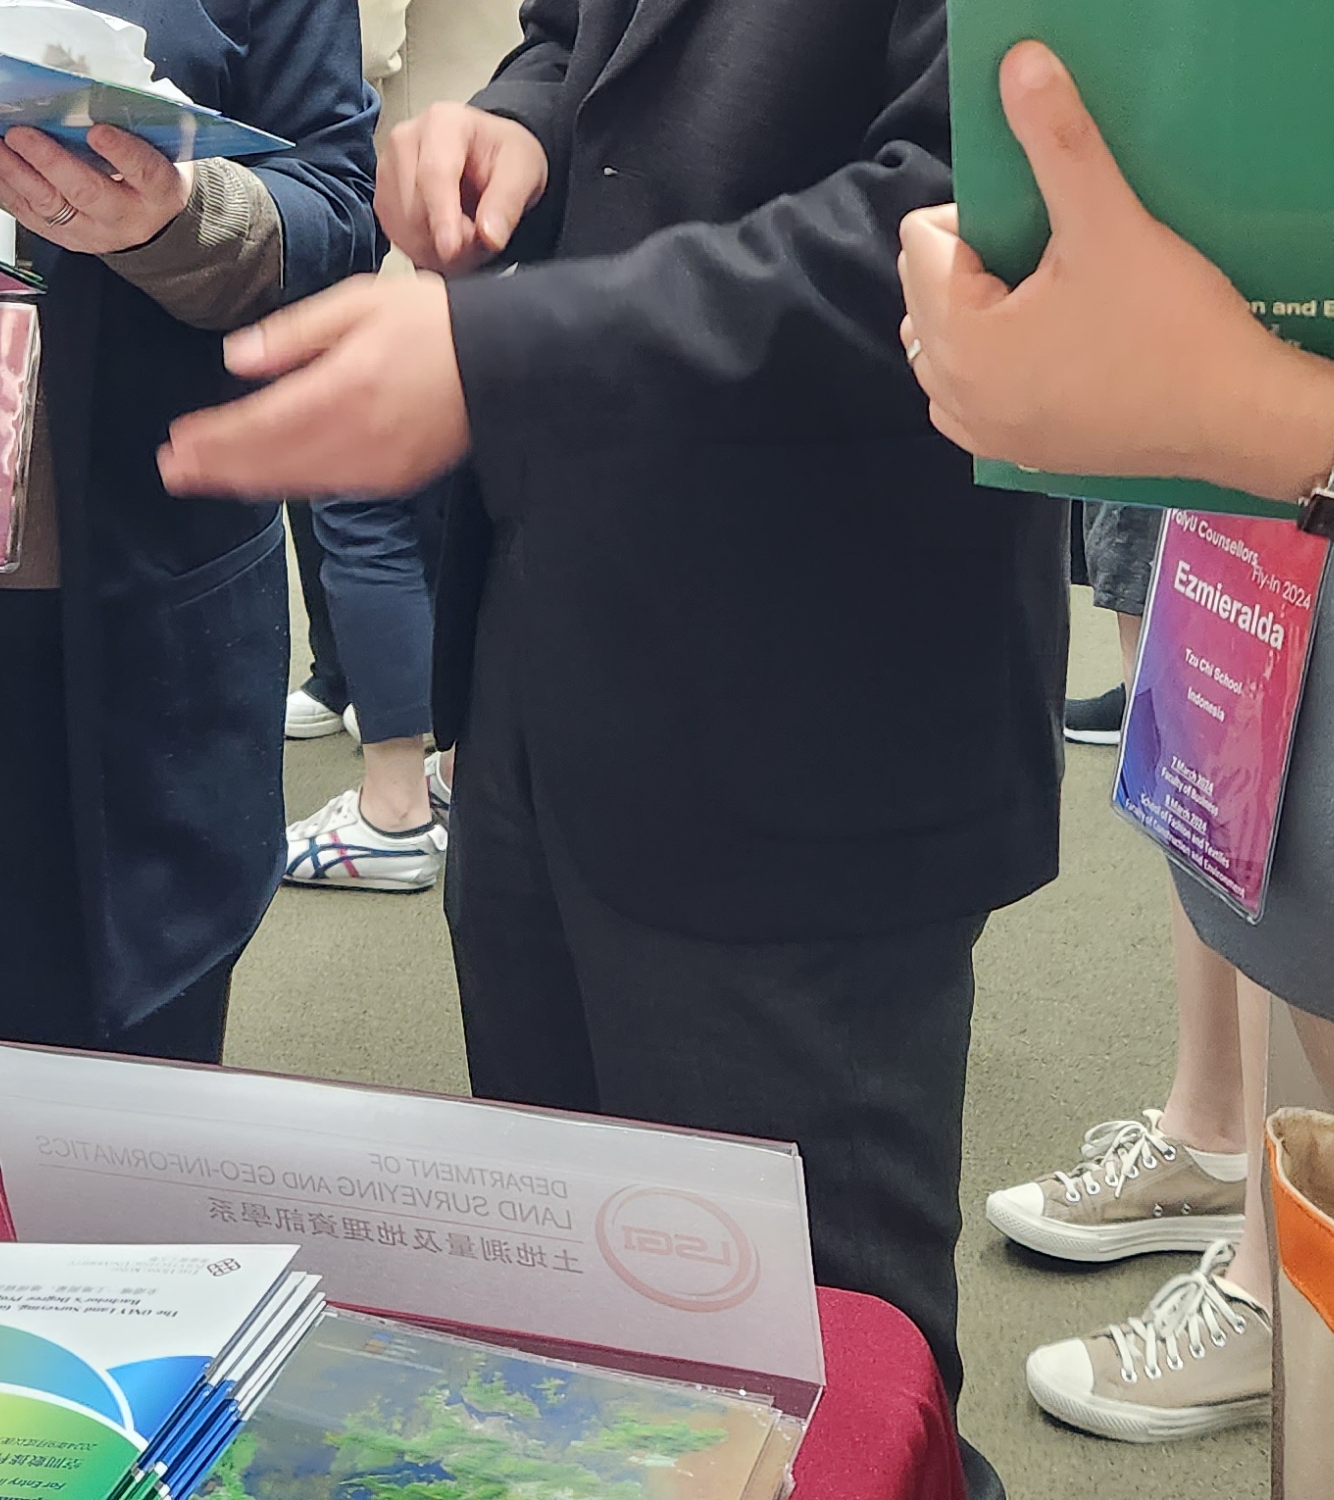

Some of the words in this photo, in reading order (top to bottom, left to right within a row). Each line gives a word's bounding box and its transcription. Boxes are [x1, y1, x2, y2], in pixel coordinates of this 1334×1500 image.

[1272, 299, 1316, 317] and
[1170, 508, 1198, 532] PolyU
[1198, 520, 1259, 567] Counsellors
[1173, 559, 1285, 651] Ezmieralda
[1251, 565, 1281, 594] Fly-In
[1282, 581, 1312, 610] 2024
[1185, 647, 1200, 668] Tzu
[1199, 658, 1215, 677] Chi
[1213, 667, 1243, 695] School
[1187, 686, 1225, 723] Indonesia
[1161, 766, 1184, 793] Faculty
[1183, 783, 1192, 797] of
[1190, 788, 1219, 818] Business
[1177, 759, 1198, 782] March
[1197, 774, 1214, 796] 2024
[1140, 792, 1161, 816] School
[1160, 809, 1169, 822] of
[1168, 813, 1192, 840] Fashion
[1191, 832, 1205, 849] and
[1204, 841, 1230, 869] Textiles
[1170, 797, 1190, 820] March
[1189, 812, 1207, 833] 2024
[1144, 813, 1154, 826] of
[1152, 820, 1191, 857] Construction
[1191, 850, 1204, 866] and
[1203, 858, 1245, 899] Environment
[26, 1295, 72, 1303] Degree
[83, 1307, 117, 1316] Land
[120, 1308, 154, 1317] ONLY
[155, 1310, 179, 1318] The
[8, 1477, 43, 1489] Entry
[45, 1480, 66, 1490] For
